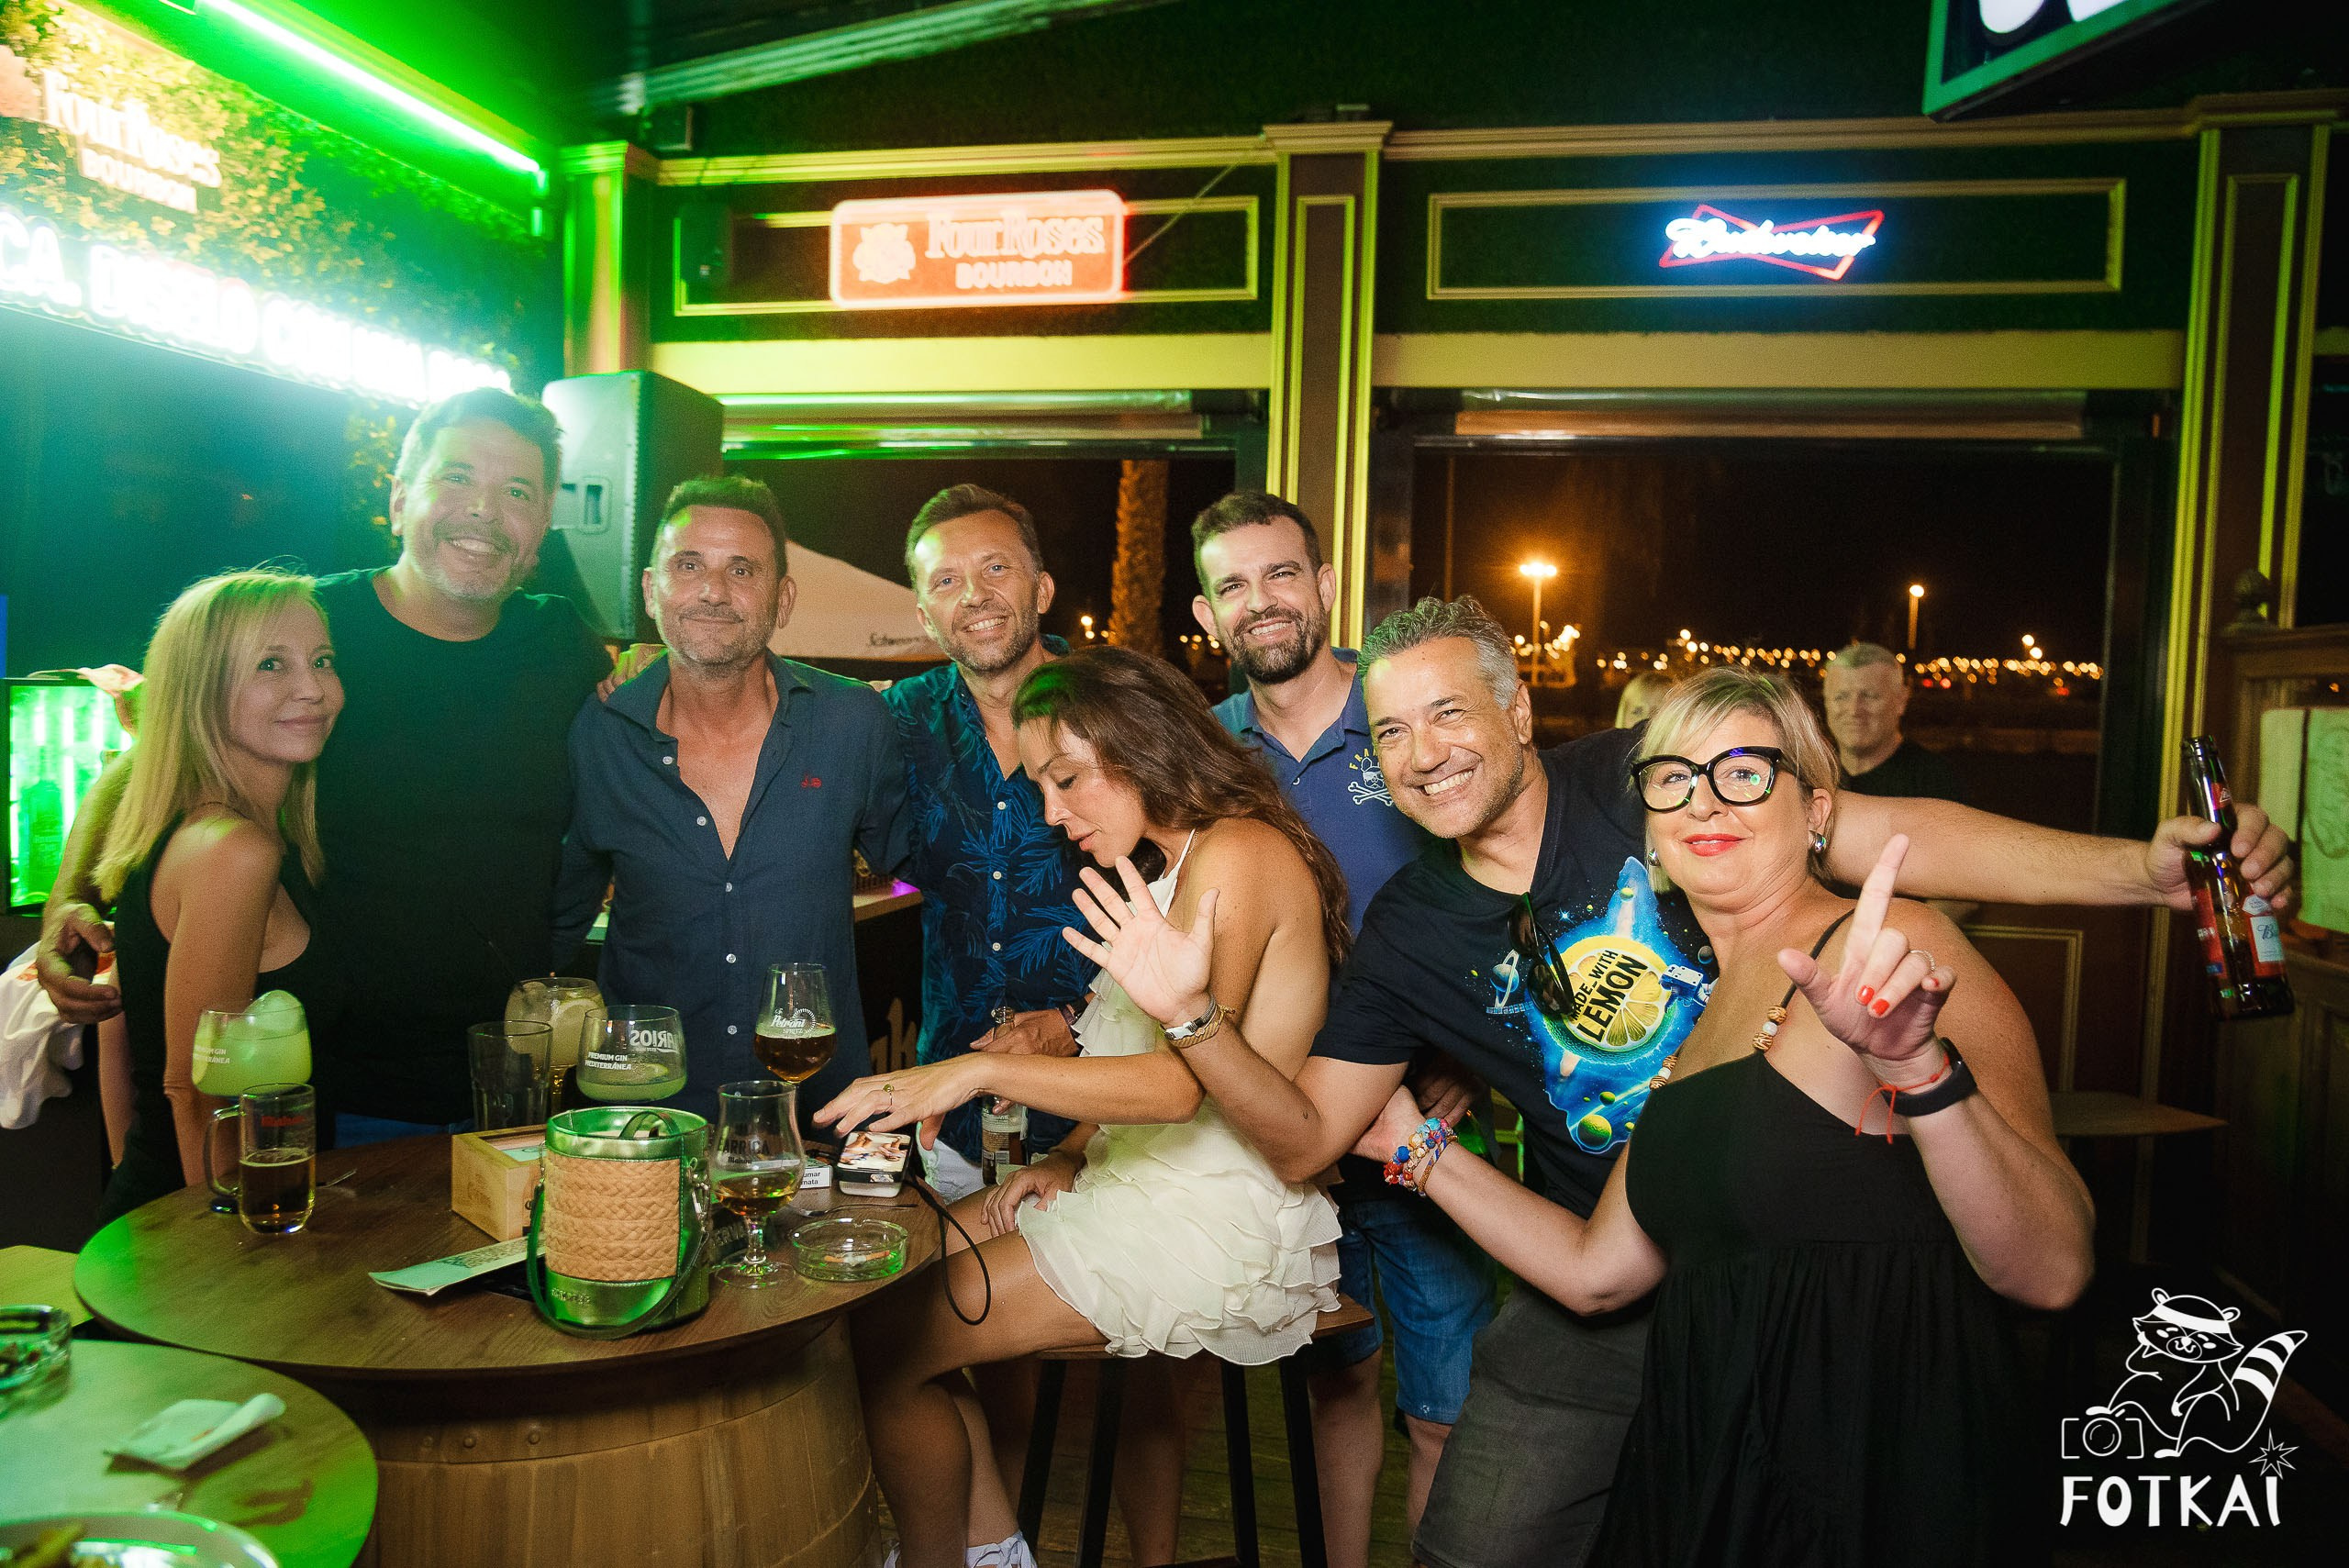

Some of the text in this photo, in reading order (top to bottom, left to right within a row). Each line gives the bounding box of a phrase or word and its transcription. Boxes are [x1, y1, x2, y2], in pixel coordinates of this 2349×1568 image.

[955, 260, 1073, 289] BOURBON
[1576, 954, 1648, 1042] LEMON
[584, 1059, 632, 1071] MEDITERRÁNEA
[587, 1051, 615, 1061] PREMIUM
